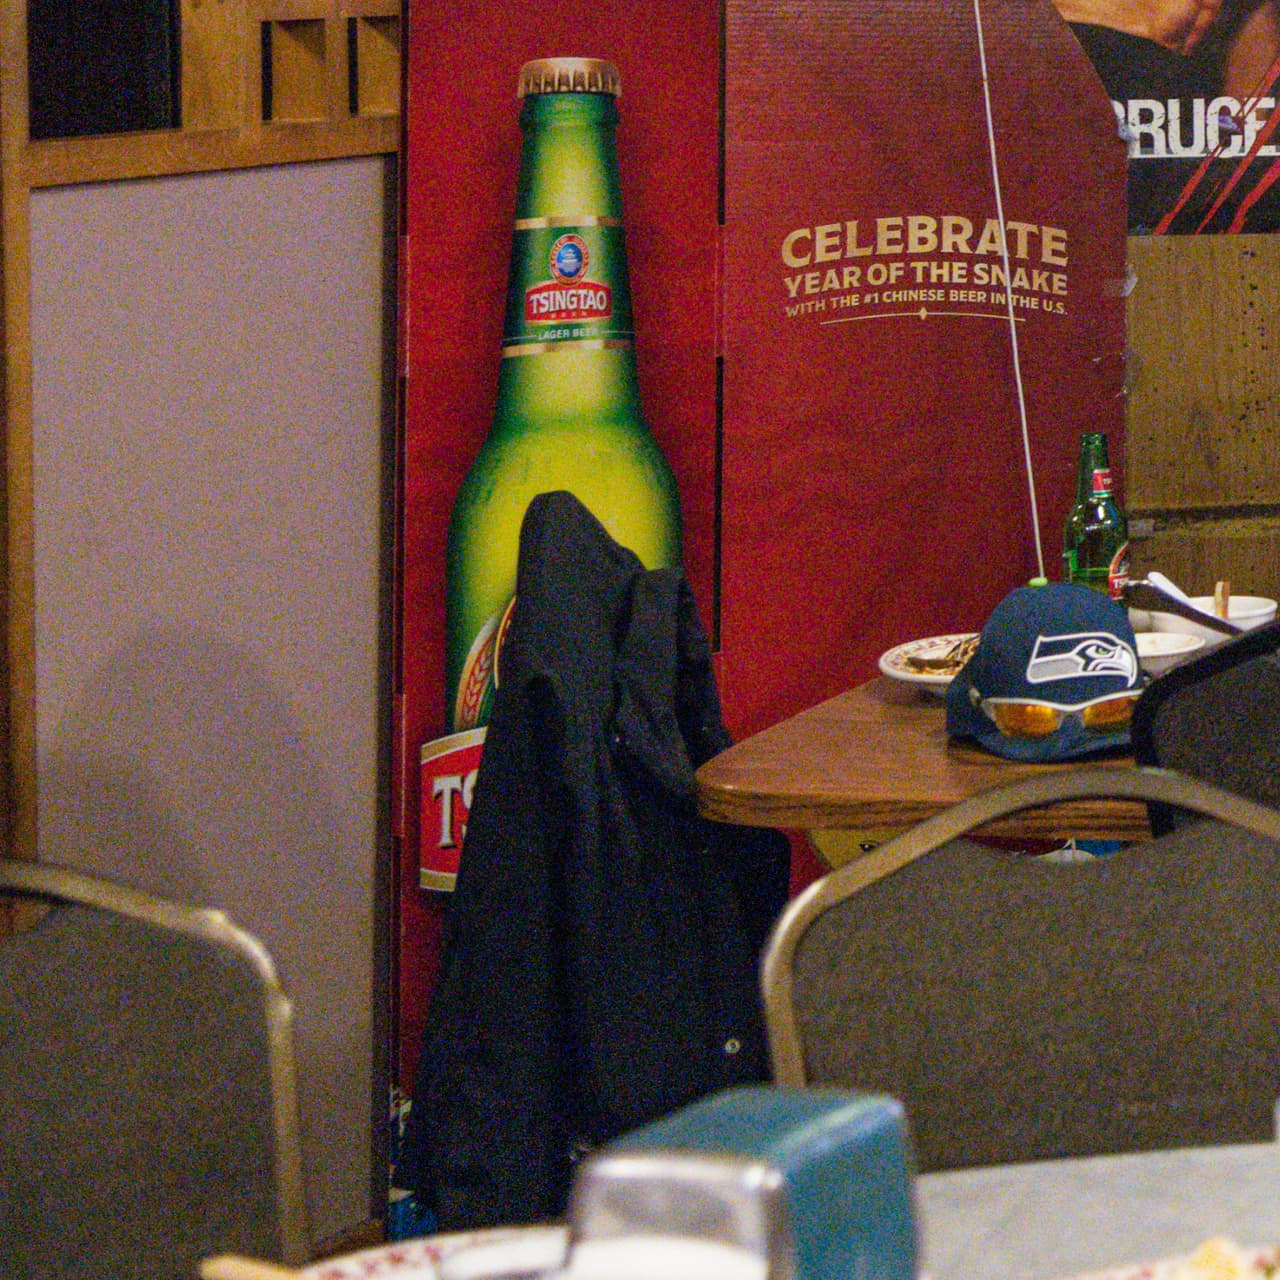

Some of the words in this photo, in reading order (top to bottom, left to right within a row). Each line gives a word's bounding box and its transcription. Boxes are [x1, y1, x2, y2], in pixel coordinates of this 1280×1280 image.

[781, 215, 1069, 268] CELEBRATE
[784, 267, 862, 298] YEAR
[867, 261, 905, 287] OF
[910, 261, 968, 284] THE
[973, 263, 1069, 297] SNAKE
[530, 289, 607, 314] TSINGTAO
[785, 300, 826, 318] WITH
[830, 293, 860, 308] THE
[863, 291, 880, 305] #1
[883, 288, 945, 303] CHINESE
[949, 289, 988, 304] BEER
[991, 291, 1006, 306] IN
[1010, 293, 1040, 310] THE
[1043, 300, 1069, 316] U.S.
